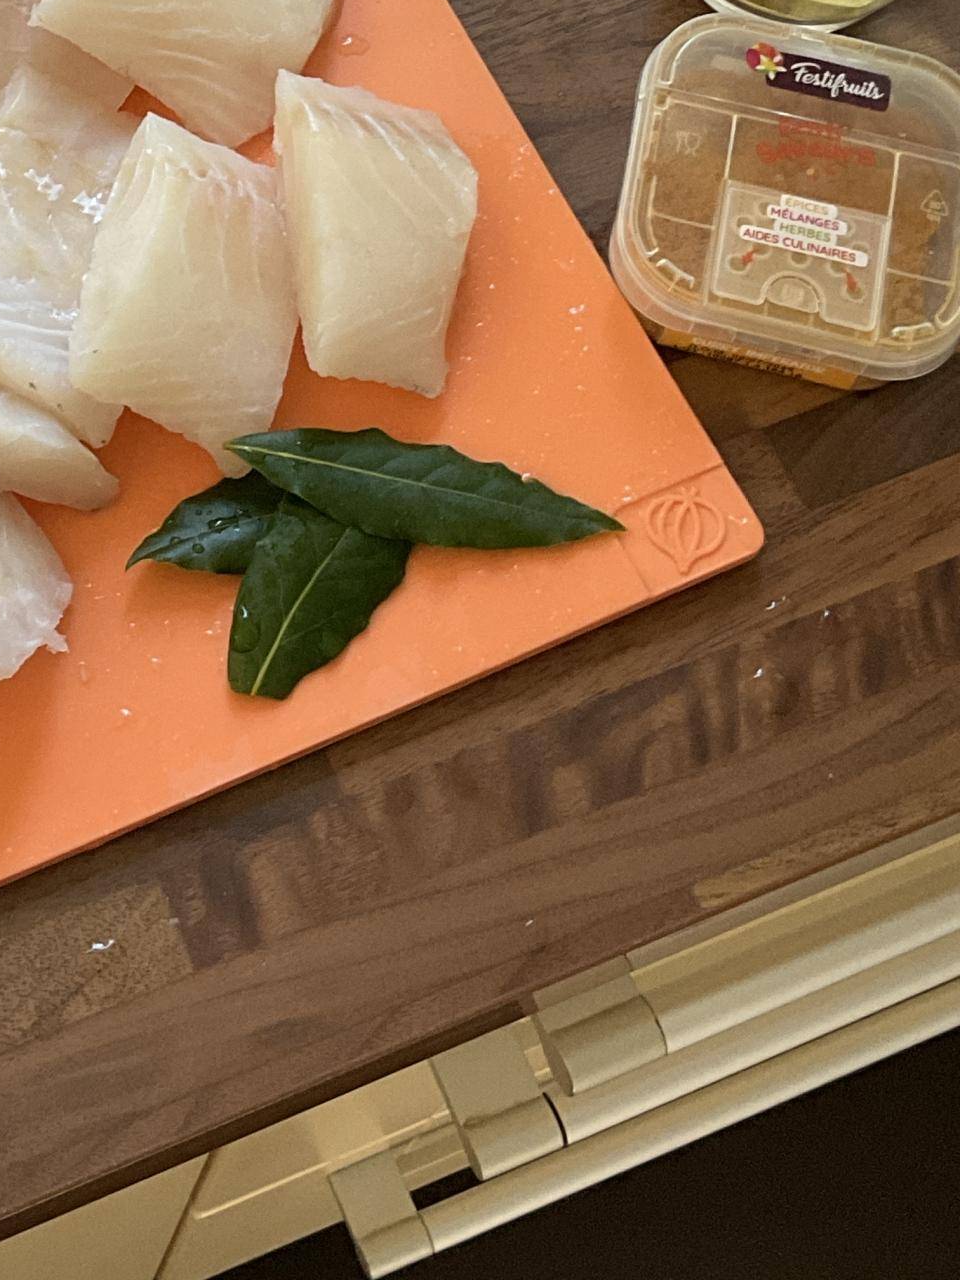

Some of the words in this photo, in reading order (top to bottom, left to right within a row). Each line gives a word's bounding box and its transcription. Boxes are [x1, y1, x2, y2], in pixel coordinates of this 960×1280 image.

[790, 62, 885, 100] Festifruits
[771, 207, 839, 231] MÉLANGES
[779, 223, 831, 242] HERBES
[743, 228, 779, 244] AIDES
[782, 236, 856, 262] CULINAIRES
